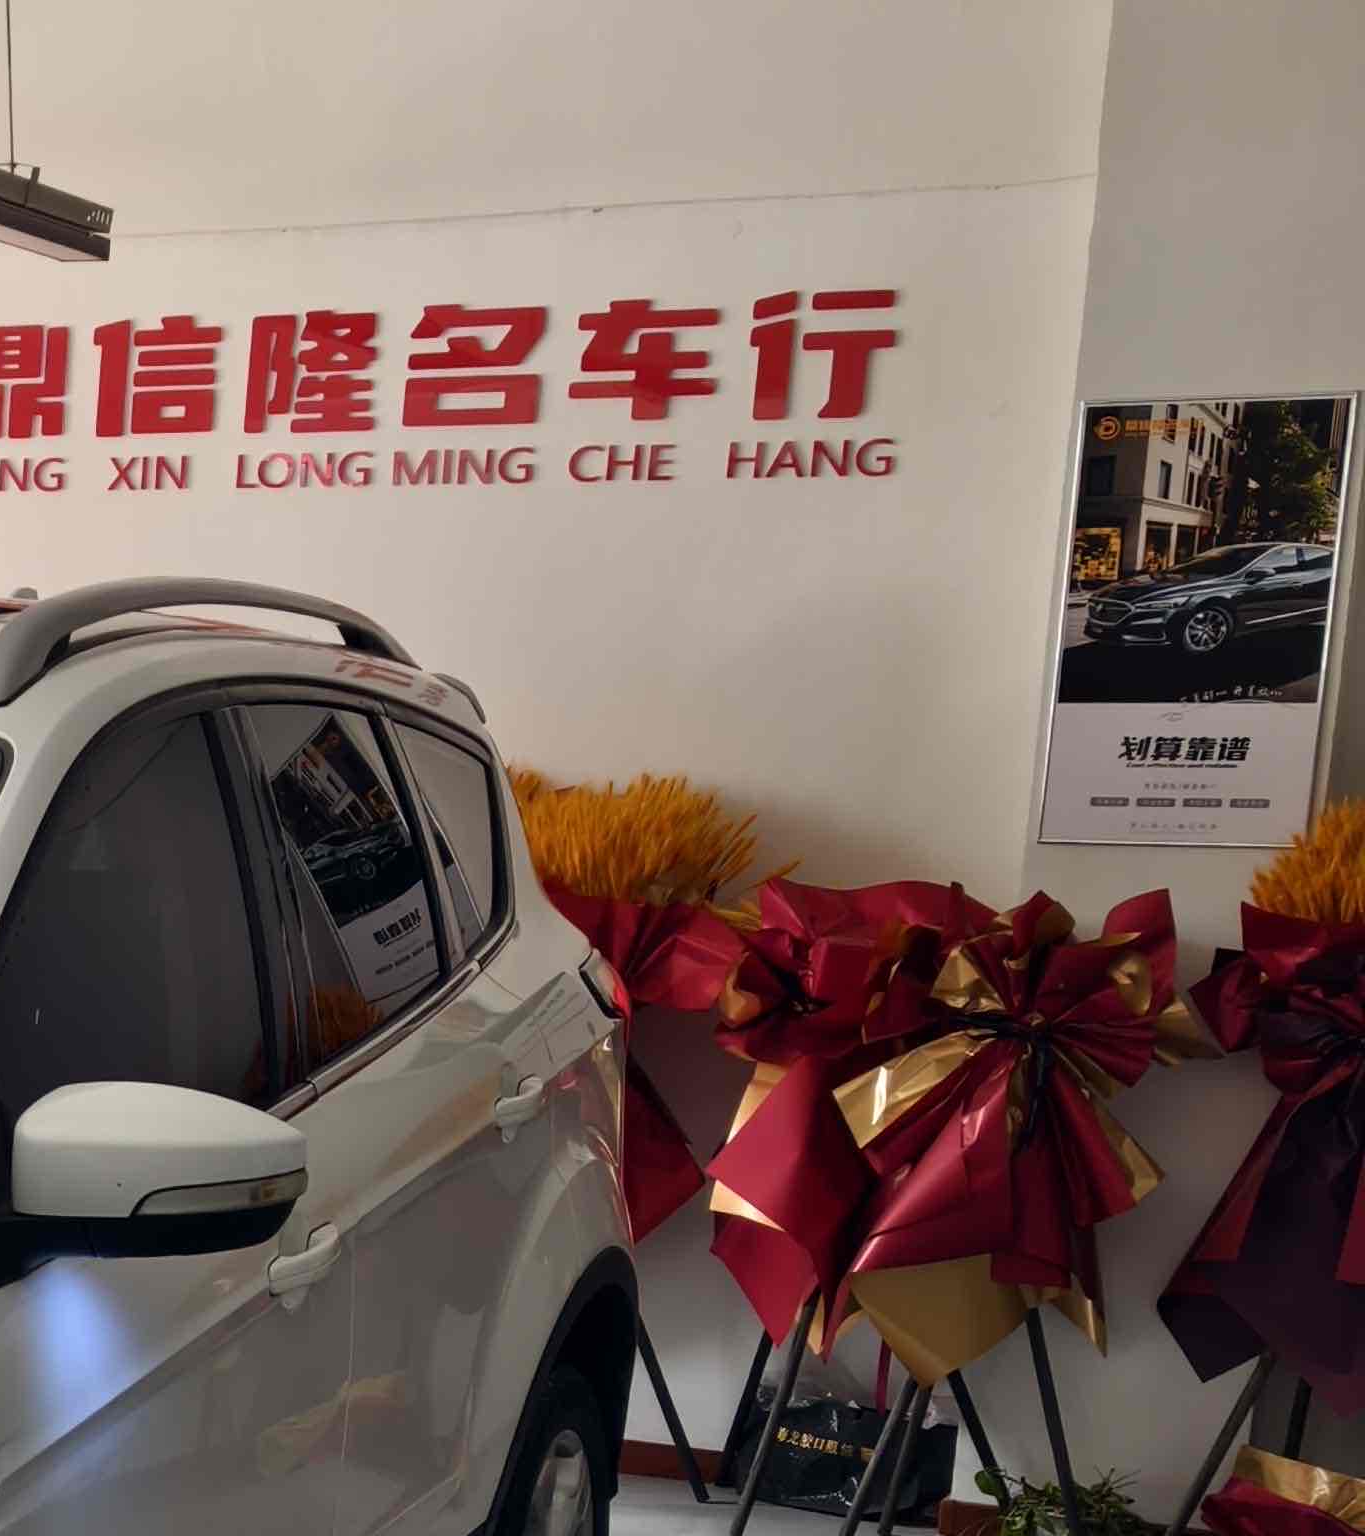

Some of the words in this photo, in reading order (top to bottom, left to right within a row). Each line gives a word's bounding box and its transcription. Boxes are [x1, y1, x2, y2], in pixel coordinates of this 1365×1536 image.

[107, 454, 190, 492] XIN
[234, 451, 372, 491] LONG
[391, 447, 537, 486] MING
[567, 443, 677, 483] CHE
[724, 438, 896, 480] HANG
[1117, 736, 1252, 762] 划算靠谱
